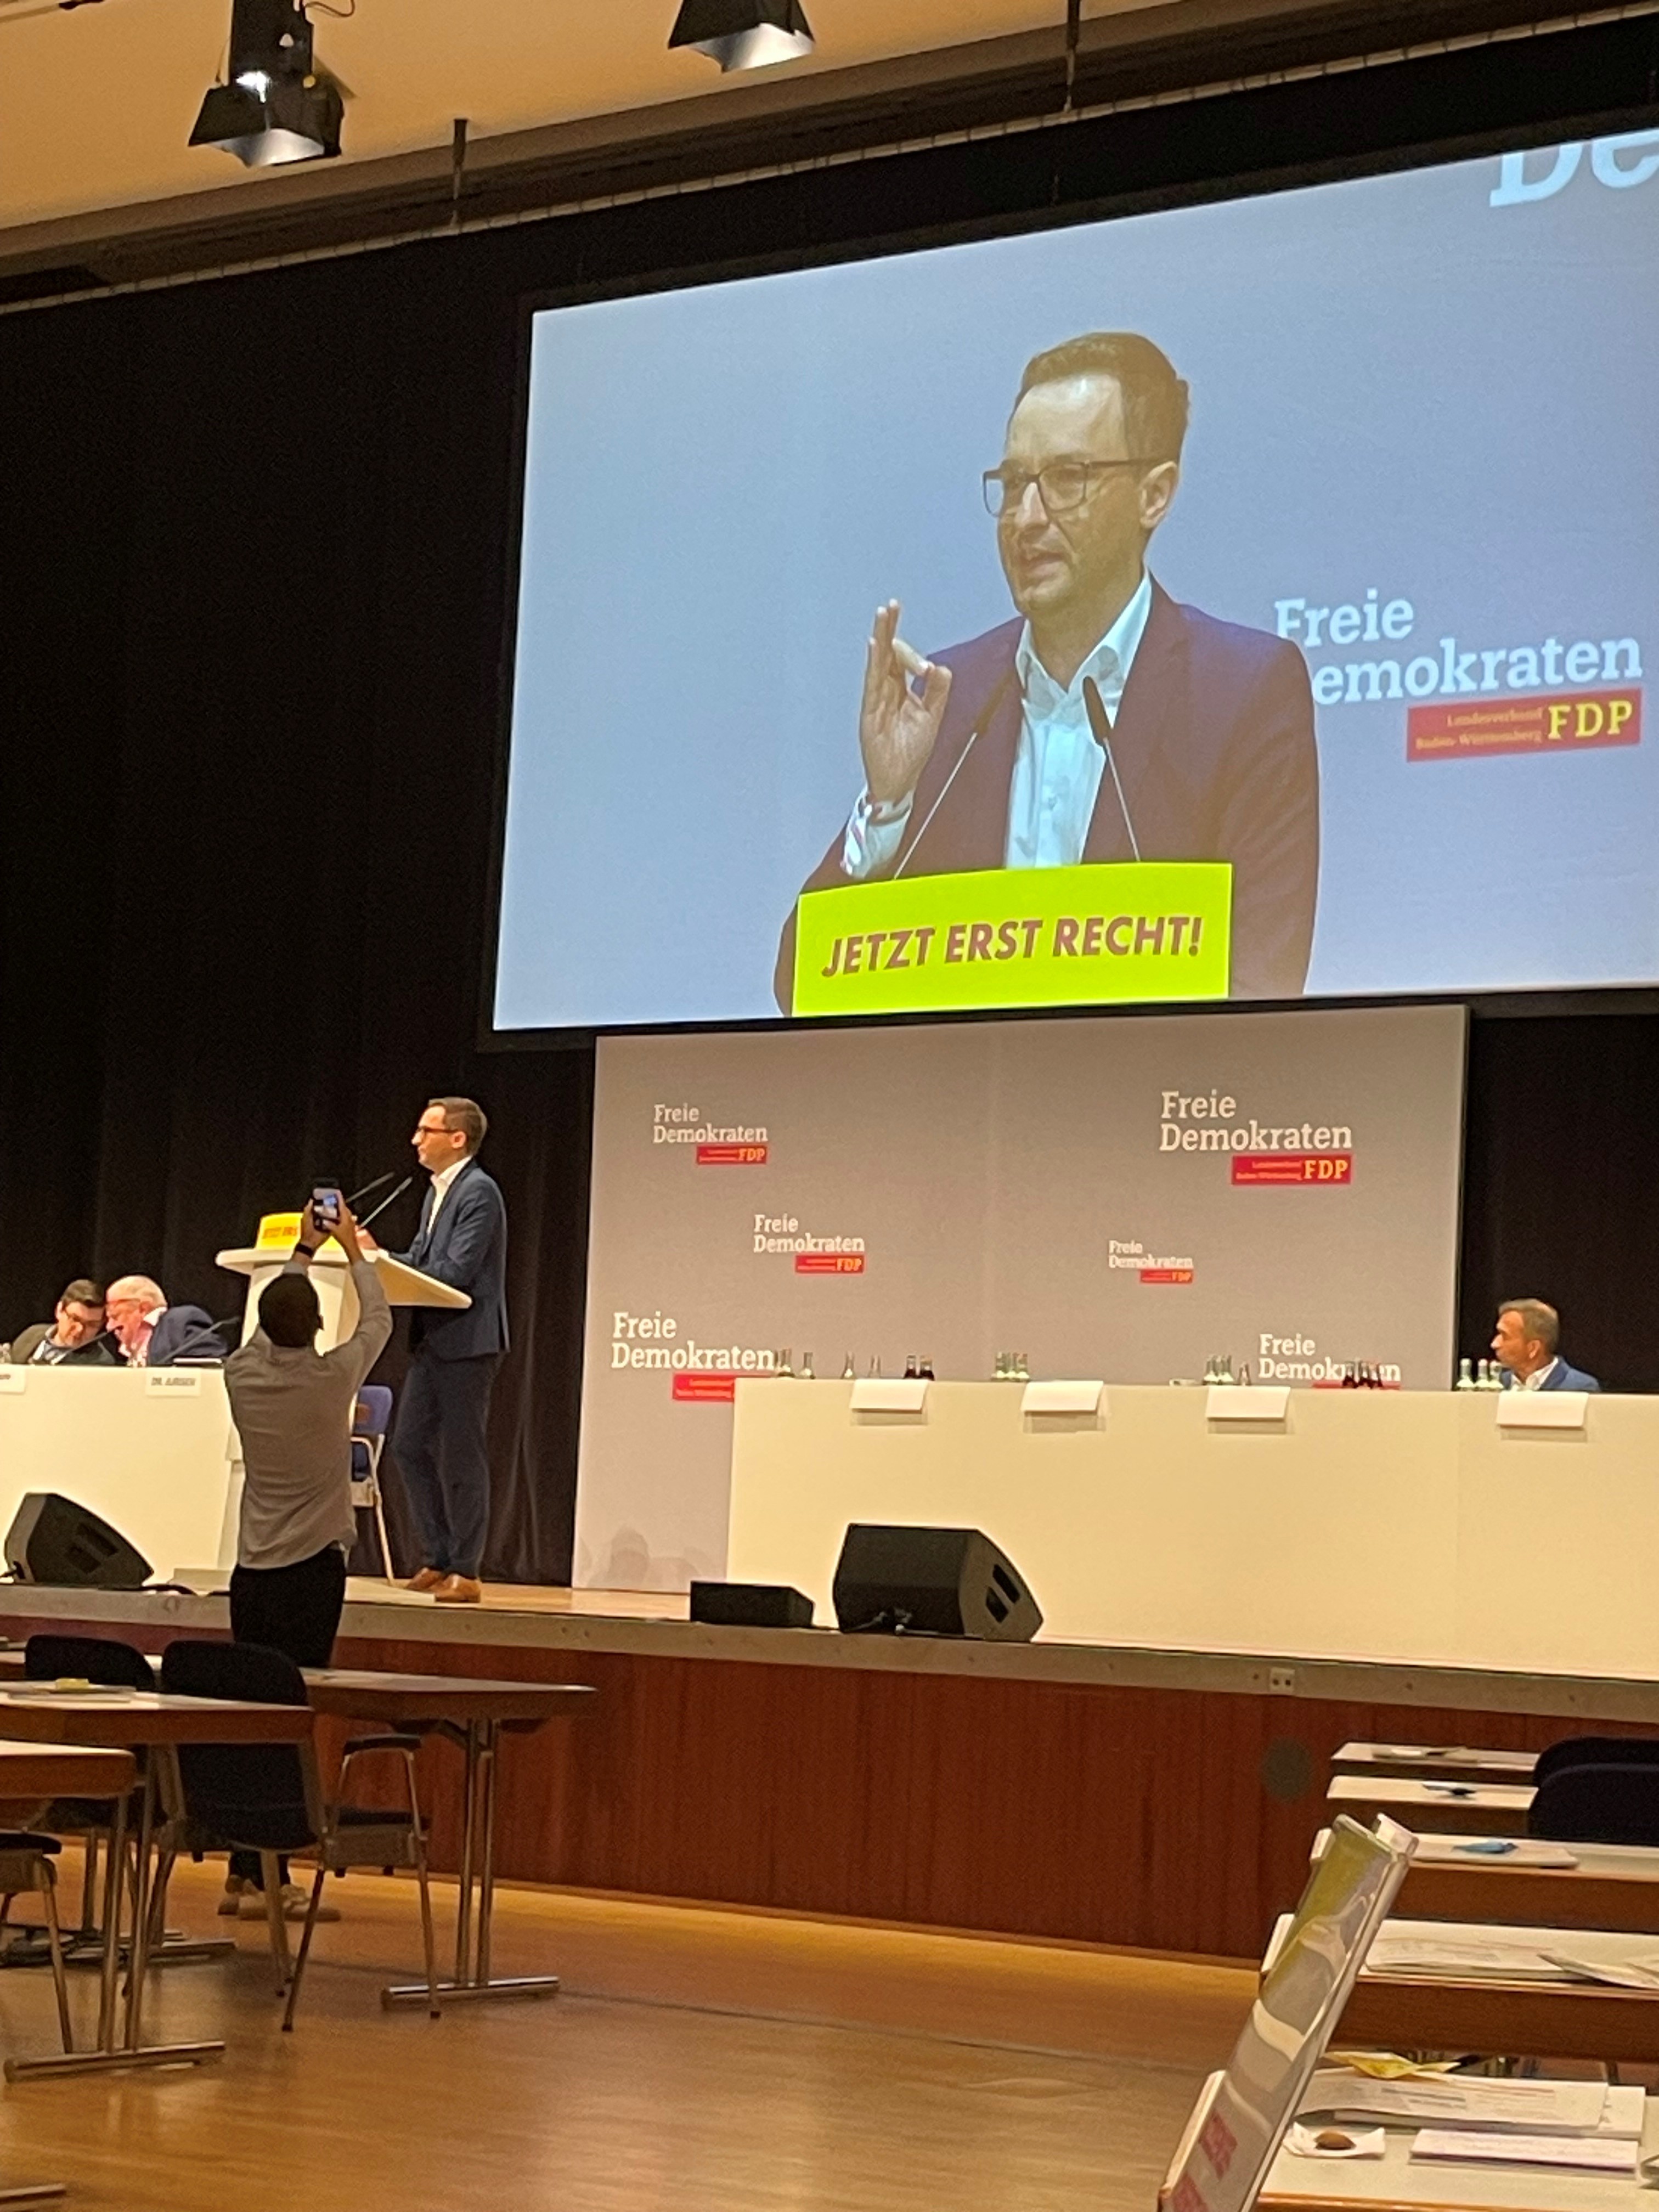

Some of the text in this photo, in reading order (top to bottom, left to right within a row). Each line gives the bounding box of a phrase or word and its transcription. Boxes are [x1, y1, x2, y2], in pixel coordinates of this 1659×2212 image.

[1274, 588, 1414, 647] Freie
[1312, 637, 1643, 704] emokraten
[1548, 700, 1633, 740] FDP
[821, 916, 1202, 978] JETZT ERST RECHT!
[654, 1103, 699, 1122] Freie
[1161, 1089, 1237, 1119] Freie
[653, 1122, 769, 1143] Demokraten
[1159, 1120, 1352, 1151] Demokraten
[738, 1148, 765, 1161] FDP
[1303, 1159, 1348, 1180] FDP
[754, 1213, 798, 1233] Freie
[754, 1233, 865, 1253] Demokraten
[836, 1258, 862, 1271] FDP
[613, 1311, 677, 1339] Freie
[611, 1340, 775, 1369] Demokraten
[1260, 1333, 1316, 1356] Freie
